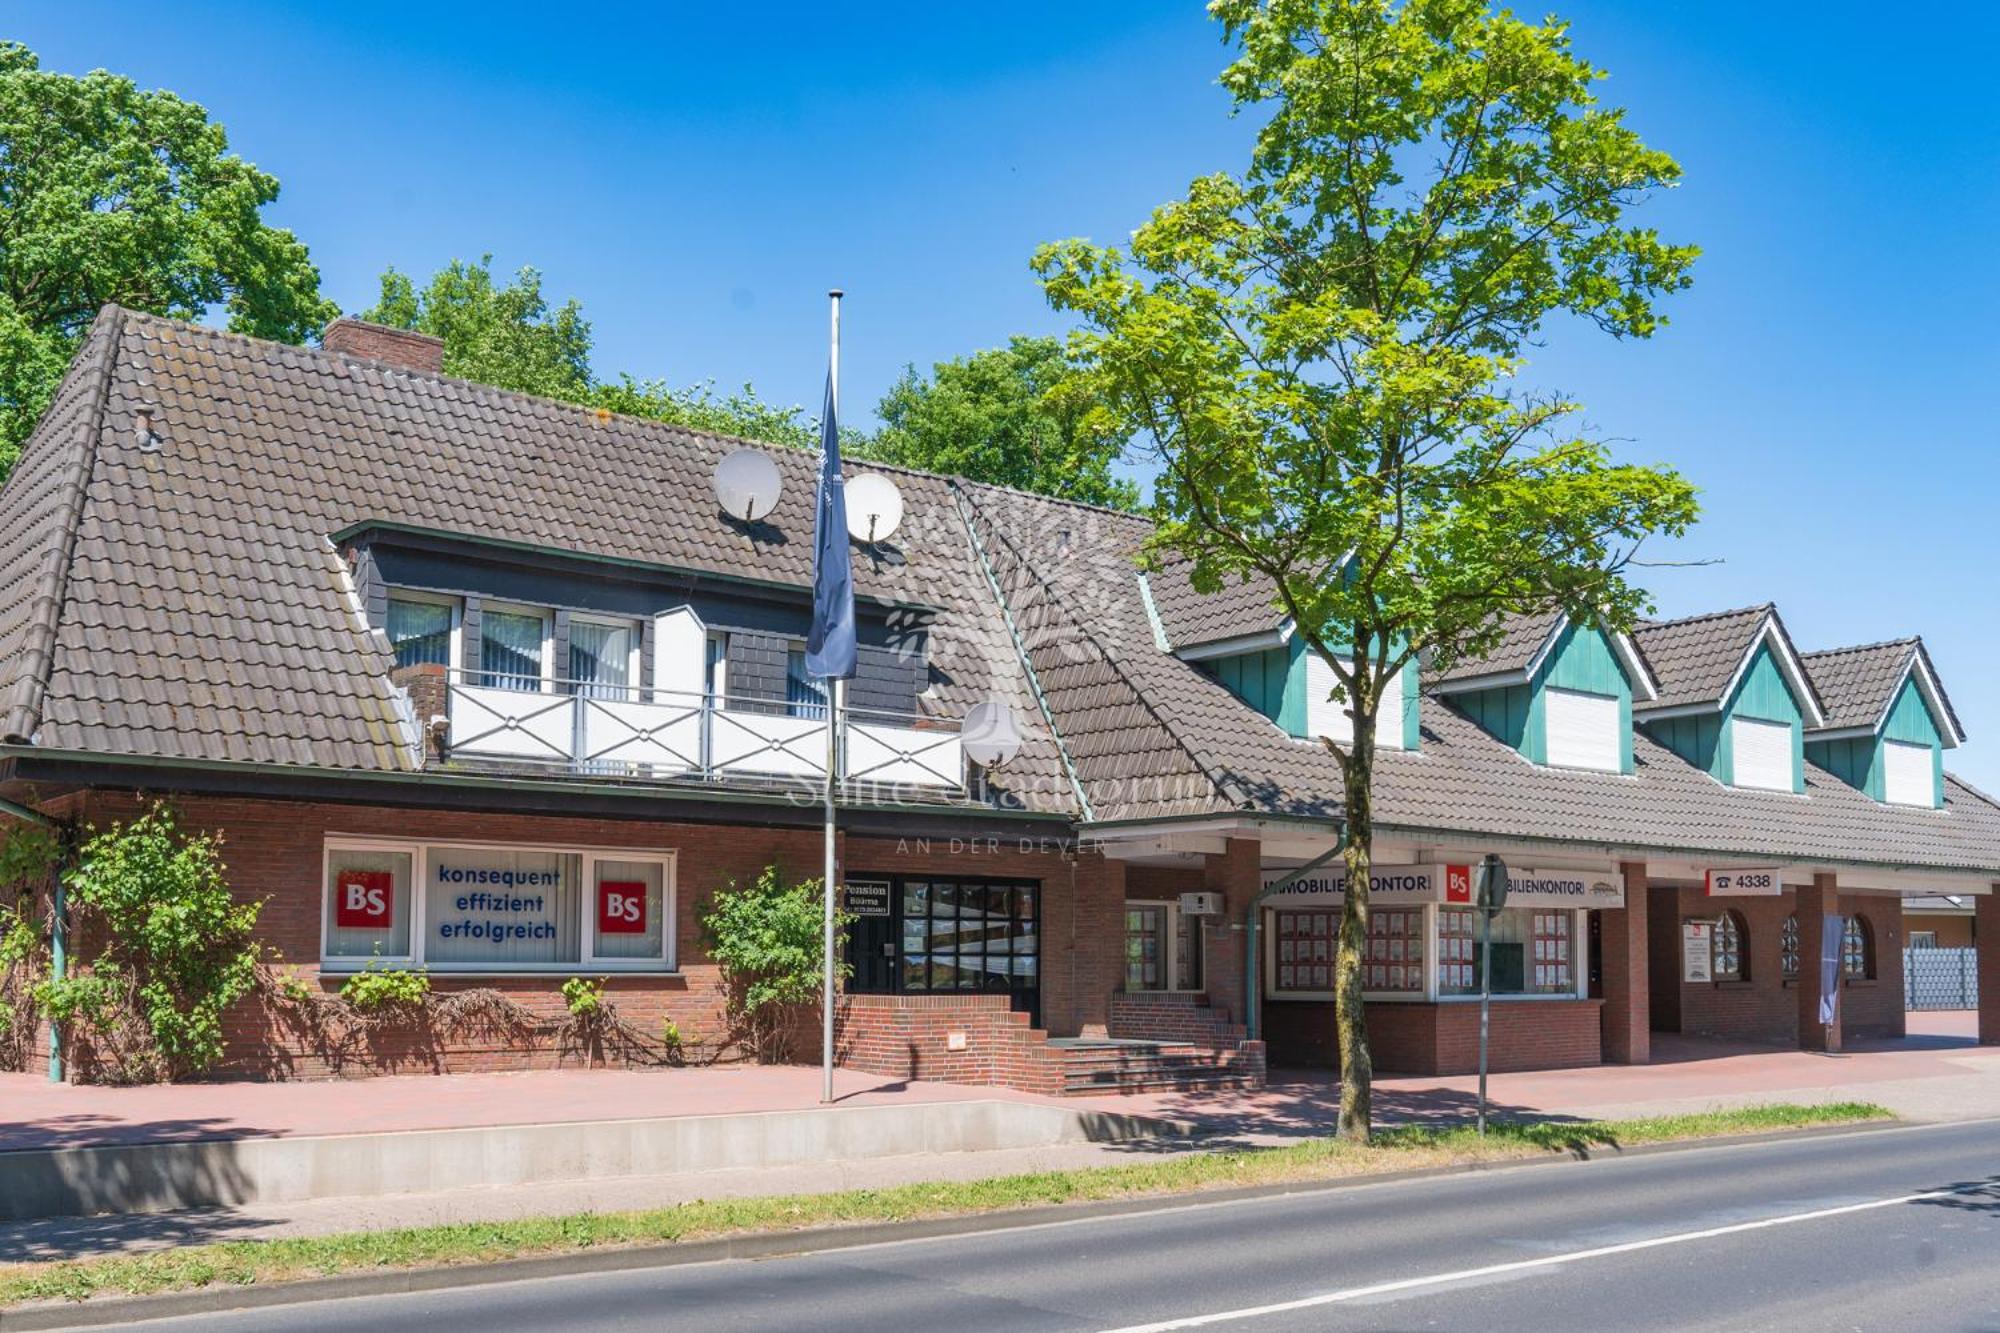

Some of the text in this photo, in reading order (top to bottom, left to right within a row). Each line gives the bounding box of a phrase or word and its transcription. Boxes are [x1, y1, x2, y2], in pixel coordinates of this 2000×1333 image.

[438, 865, 561, 888] konsequent
[1263, 876, 1426, 895] IMOBILIEONTOR
[1450, 873, 1468, 893] BS
[1736, 875, 1771, 889] 4338
[843, 884, 886, 895] Pension
[346, 884, 386, 916] BS
[456, 892, 544, 912] effizient
[606, 892, 641, 923] BS
[440, 920, 557, 943] erfolgreich
